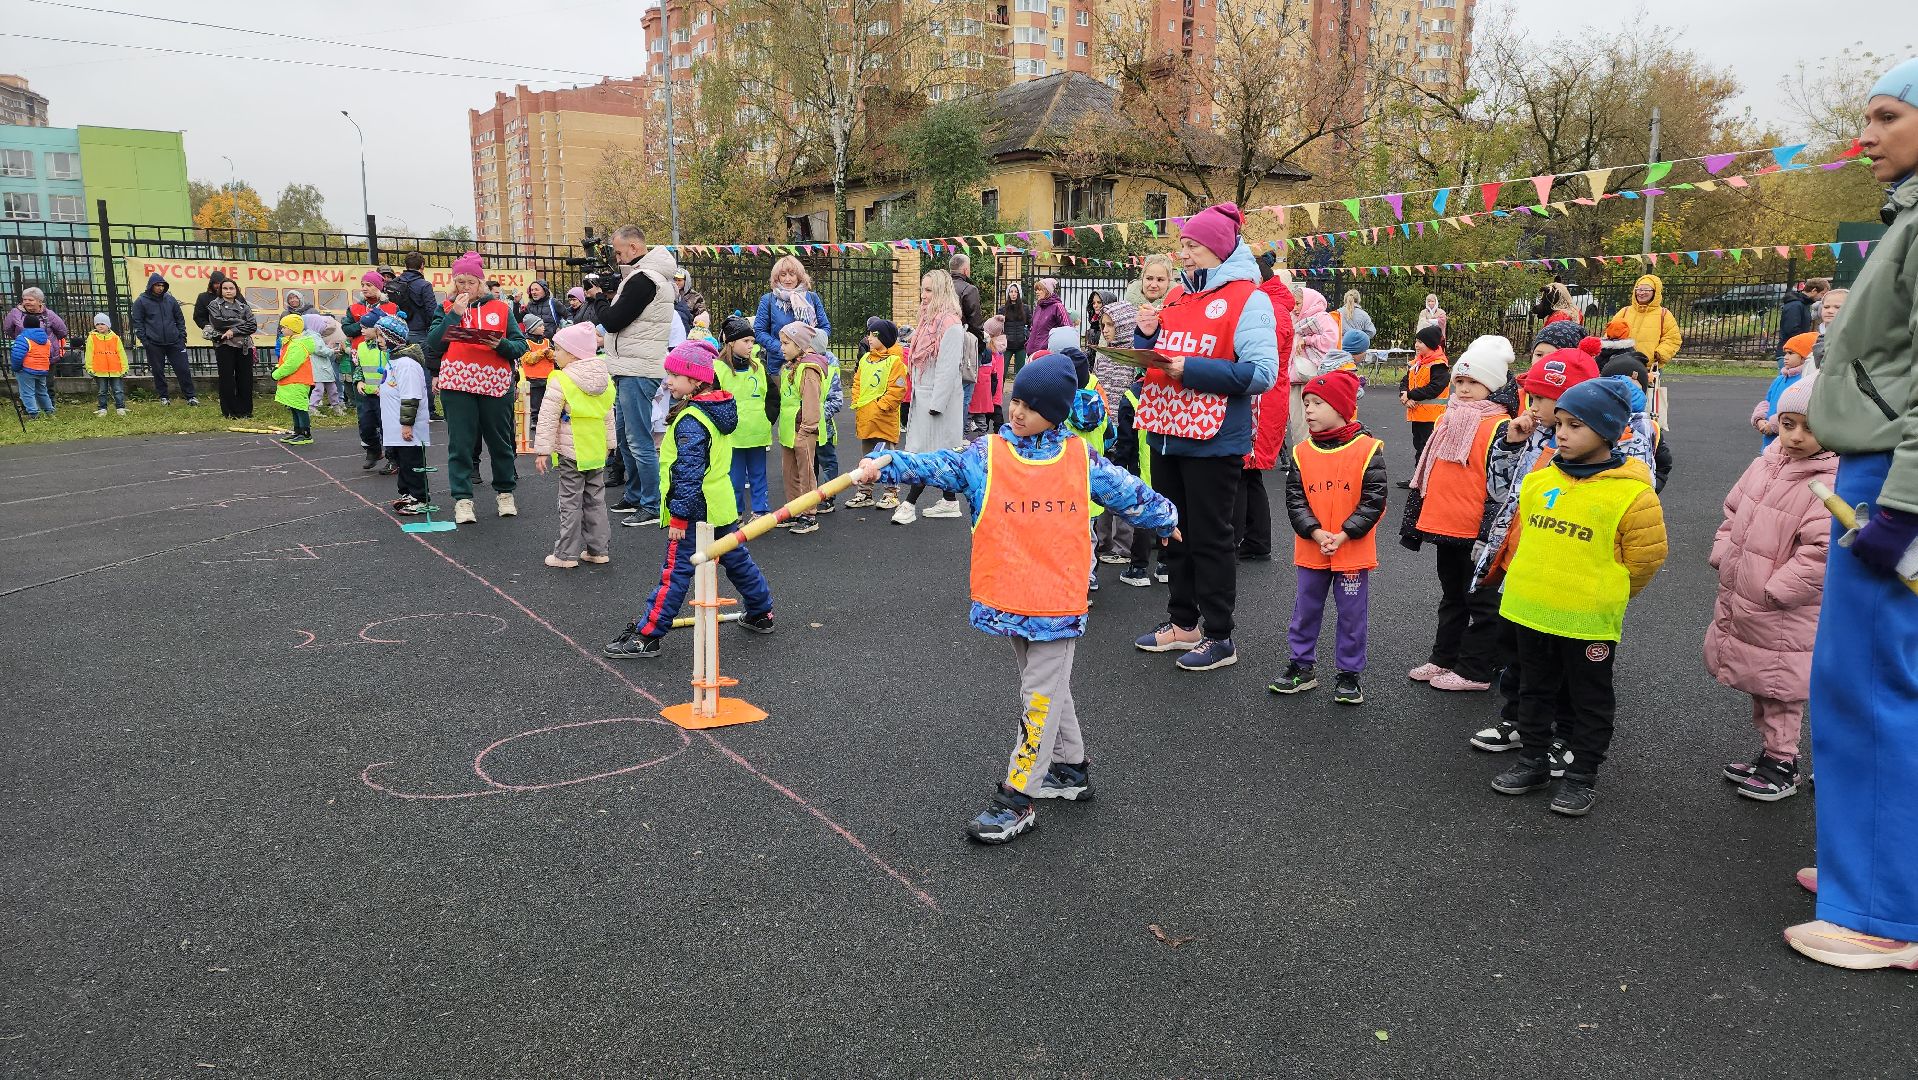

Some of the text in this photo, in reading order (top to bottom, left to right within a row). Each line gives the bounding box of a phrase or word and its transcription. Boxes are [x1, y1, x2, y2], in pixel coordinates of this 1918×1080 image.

[248, 267, 344, 284] ГОРОДКИ
[432, 272, 454, 288] ДЛ
[488, 274, 524, 287] СЕХ!
[1154, 329, 1218, 357] УДЬЯ
[748, 376, 761, 398] 2
[1308, 480, 1351, 493] KIPTA
[1004, 500, 1078, 513] KIPSTA
